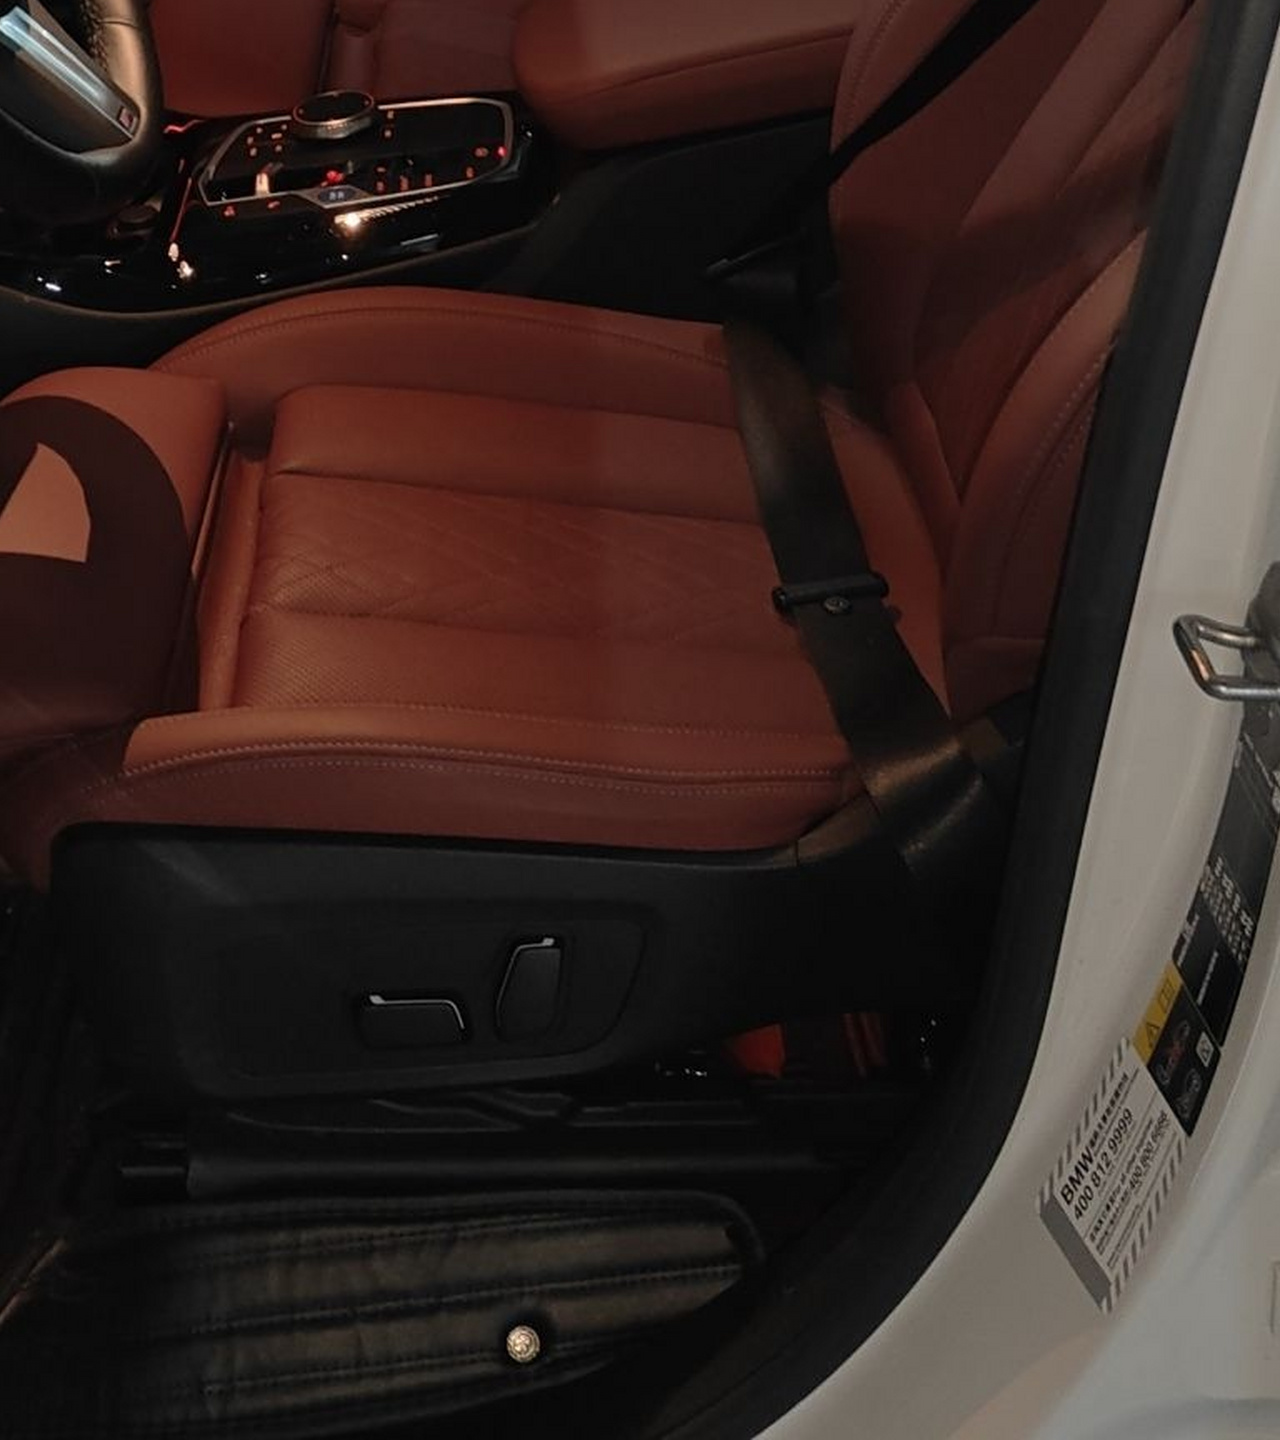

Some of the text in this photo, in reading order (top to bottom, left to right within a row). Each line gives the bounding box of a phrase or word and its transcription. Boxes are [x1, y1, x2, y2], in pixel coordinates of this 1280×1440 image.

[1060, 1147, 1094, 1206] BMW
[1072, 1184, 1094, 1221] 400
[1090, 1151, 1112, 1188] 812
[1107, 1107, 1133, 1154] 9999
